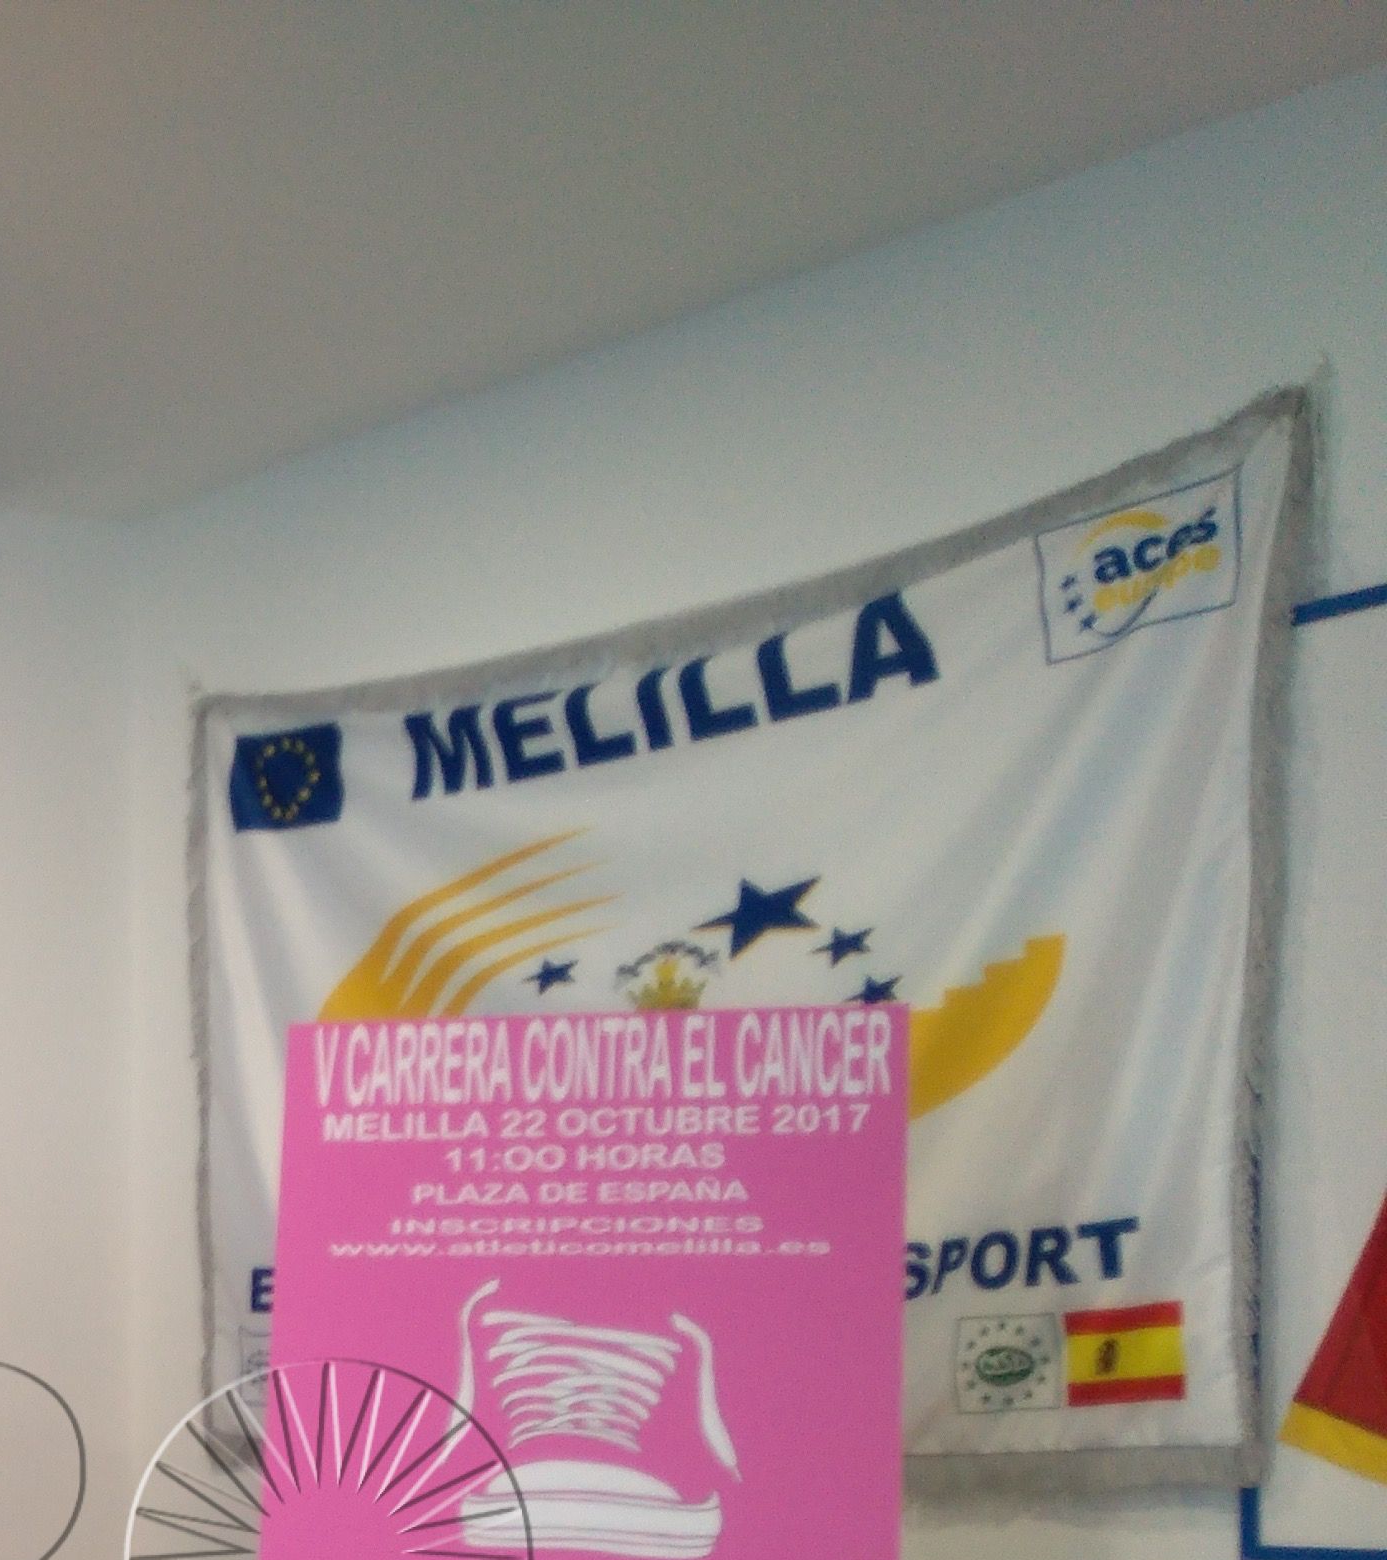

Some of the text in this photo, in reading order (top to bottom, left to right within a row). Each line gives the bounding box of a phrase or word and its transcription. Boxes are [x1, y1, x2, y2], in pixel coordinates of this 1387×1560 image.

[404, 588, 940, 800] MELILLA
[315, 1010, 892, 1107] V CARRERA CONTRA EL CANCER
[322, 1103, 872, 1142] MELILLA 22 OCTUBRE 2017
[576, 1142, 726, 1171] HORAS
[411, 1176, 750, 1206] PLAZA DE ESPAÑA
[390, 1215, 765, 1236] INSCRIPCIONES
[906, 1216, 1139, 1301] SPORT
